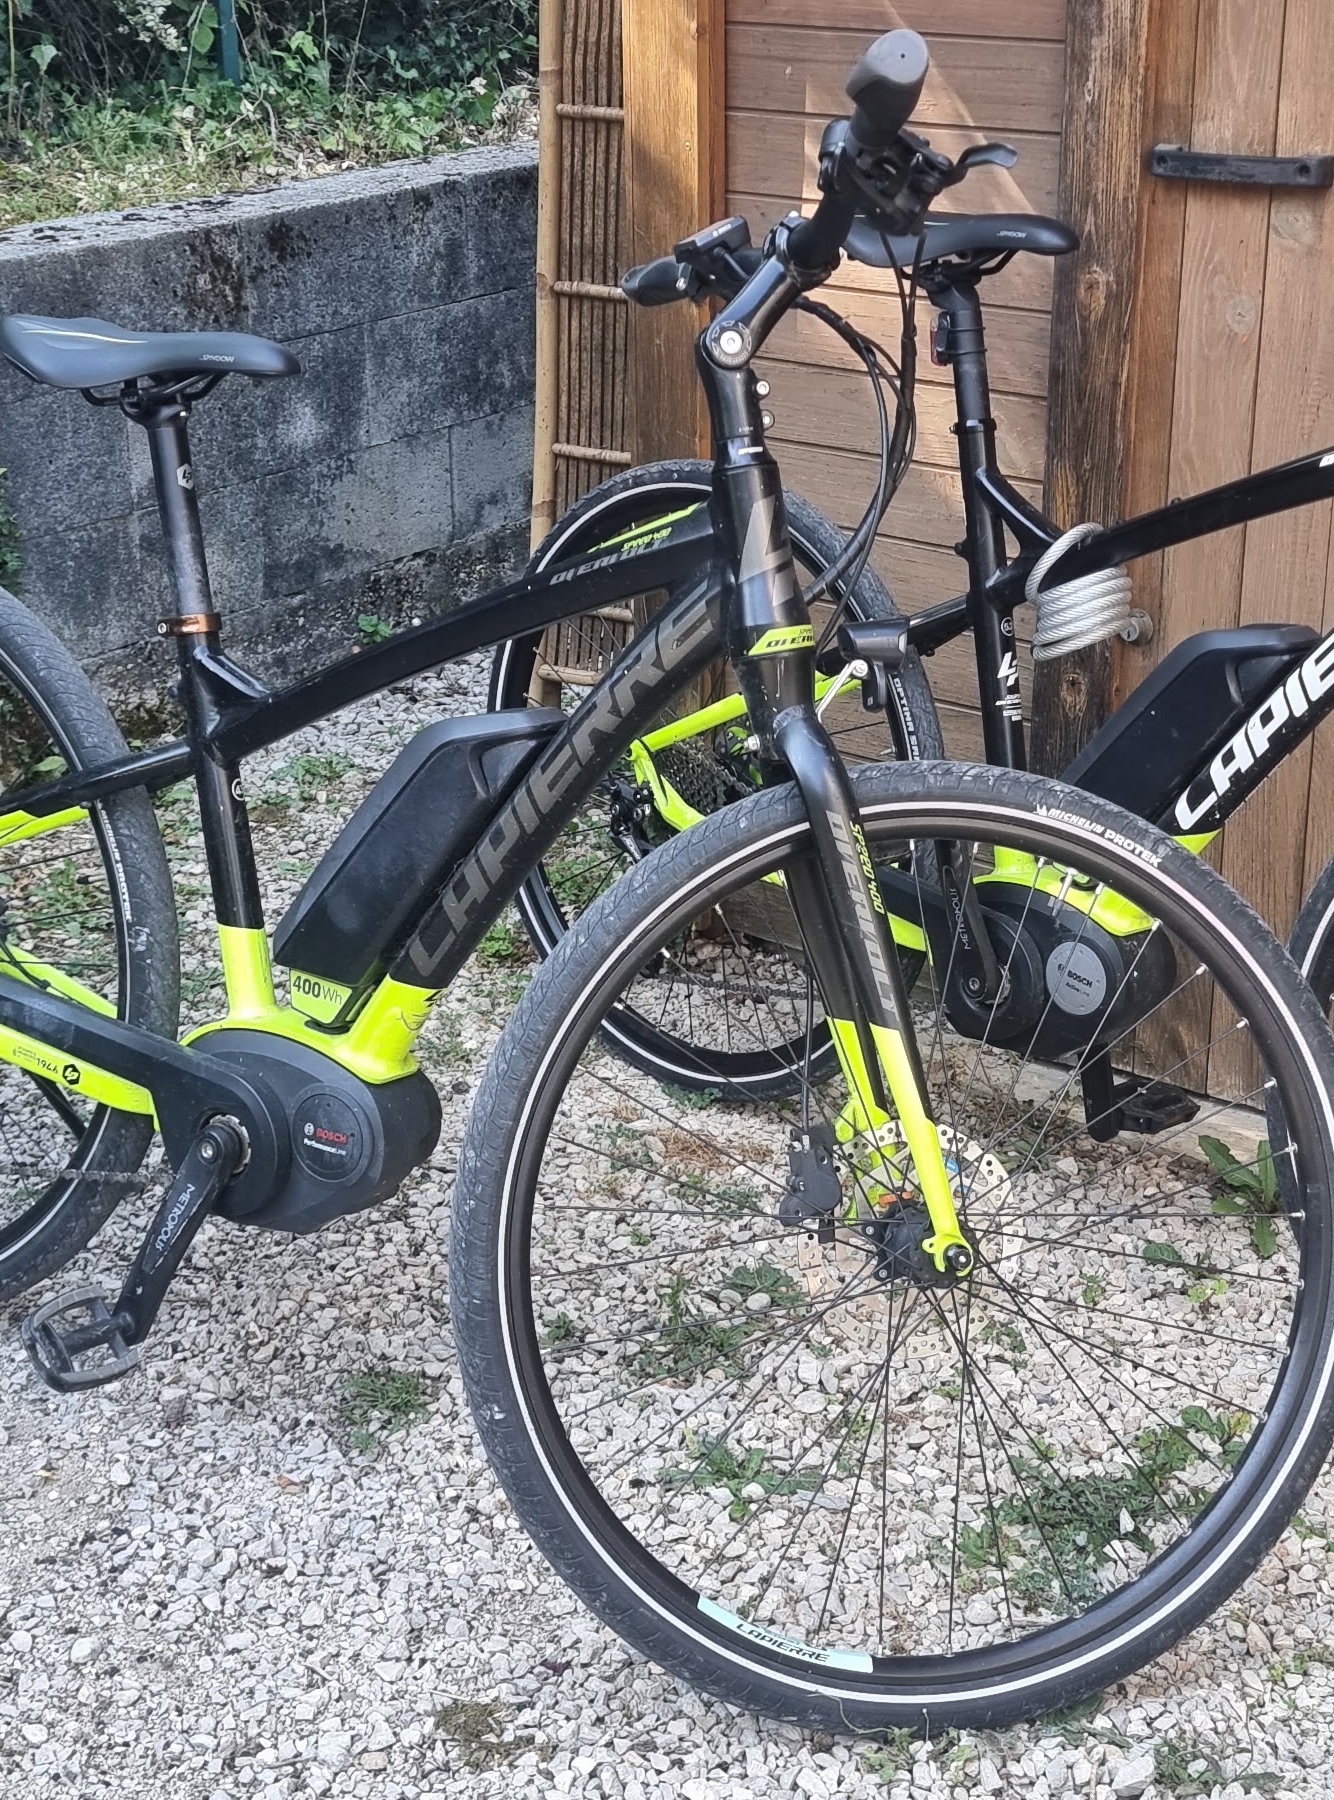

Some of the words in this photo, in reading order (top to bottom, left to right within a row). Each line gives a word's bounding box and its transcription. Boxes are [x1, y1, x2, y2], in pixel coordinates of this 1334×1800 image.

[407, 577, 714, 978] LAPIERRE
[1047, 808, 1107, 834] MICHELIN
[1104, 828, 1163, 868] PROTEK
[115, 862, 133, 923] PROTEK
[825, 809, 901, 1023] OVERVOLT
[868, 881, 886, 915] 400
[1067, 969, 1093, 989] BOSCH
[315, 1127, 347, 1145] BOSCH
[155, 1186, 196, 1252] METROPOLIS
[735, 1622, 831, 1663] LAPIERRE
